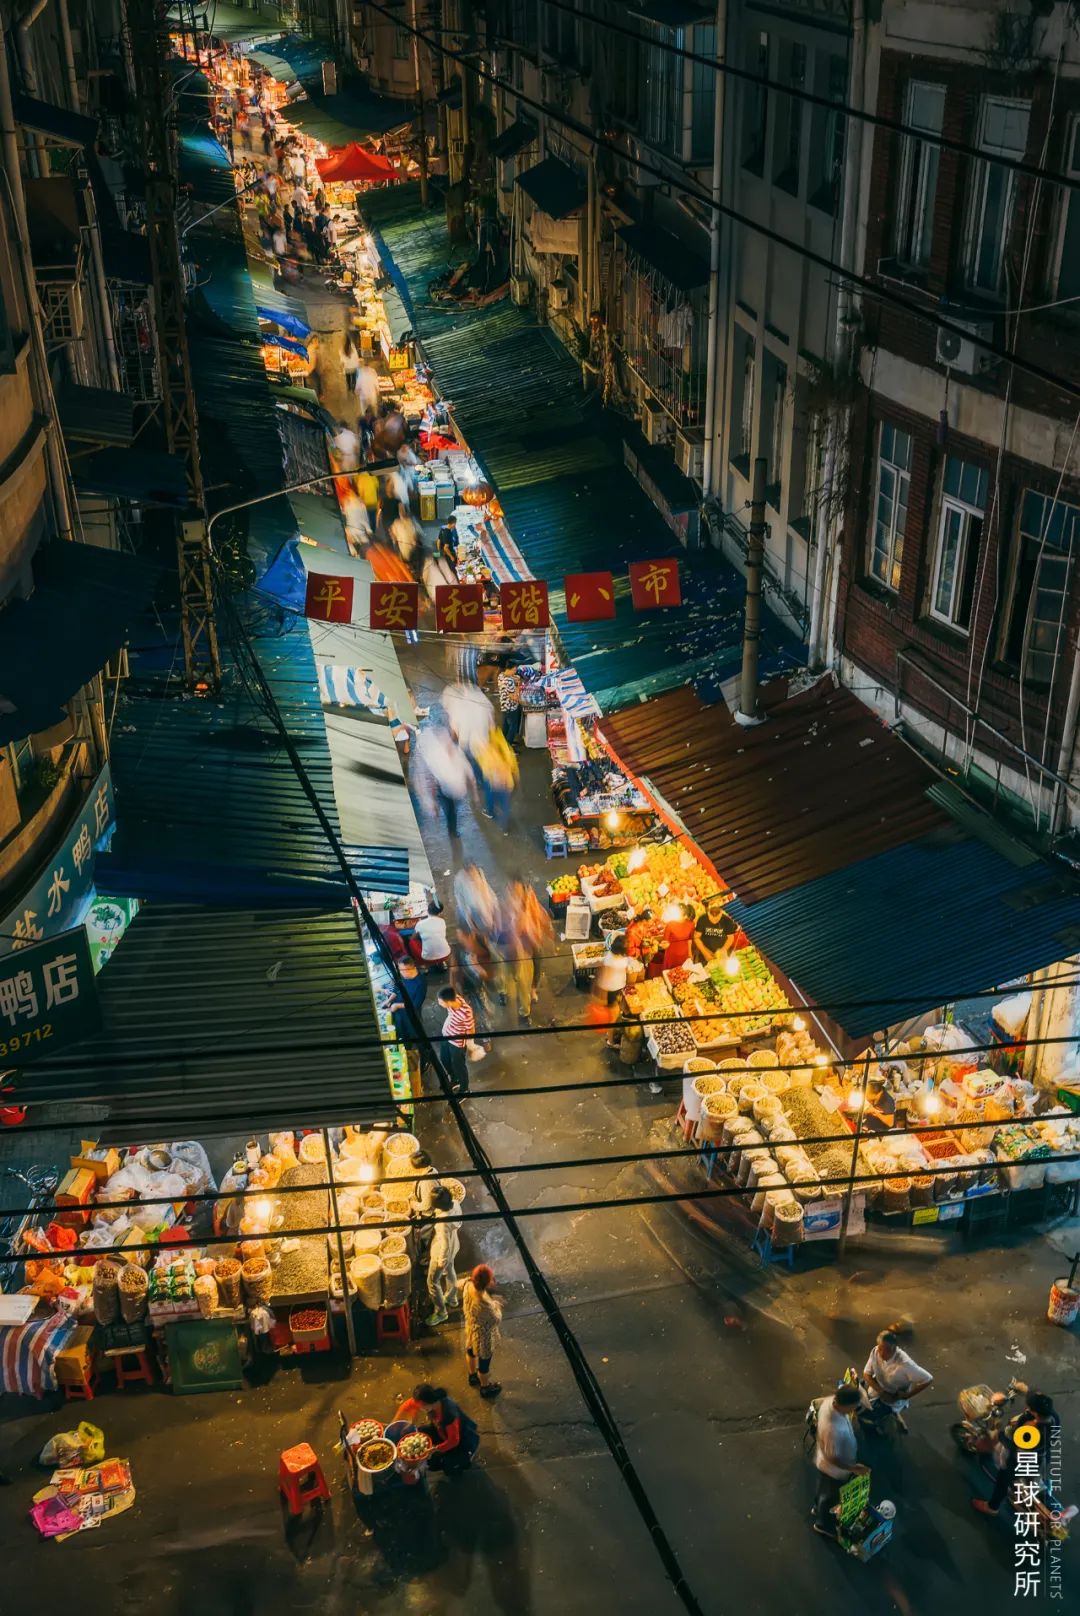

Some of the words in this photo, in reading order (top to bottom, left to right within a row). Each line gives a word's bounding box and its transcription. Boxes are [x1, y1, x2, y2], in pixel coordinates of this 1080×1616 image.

[313, 564, 671, 627] 平安和谐八市
[0, 953, 79, 1026] 鸭店
